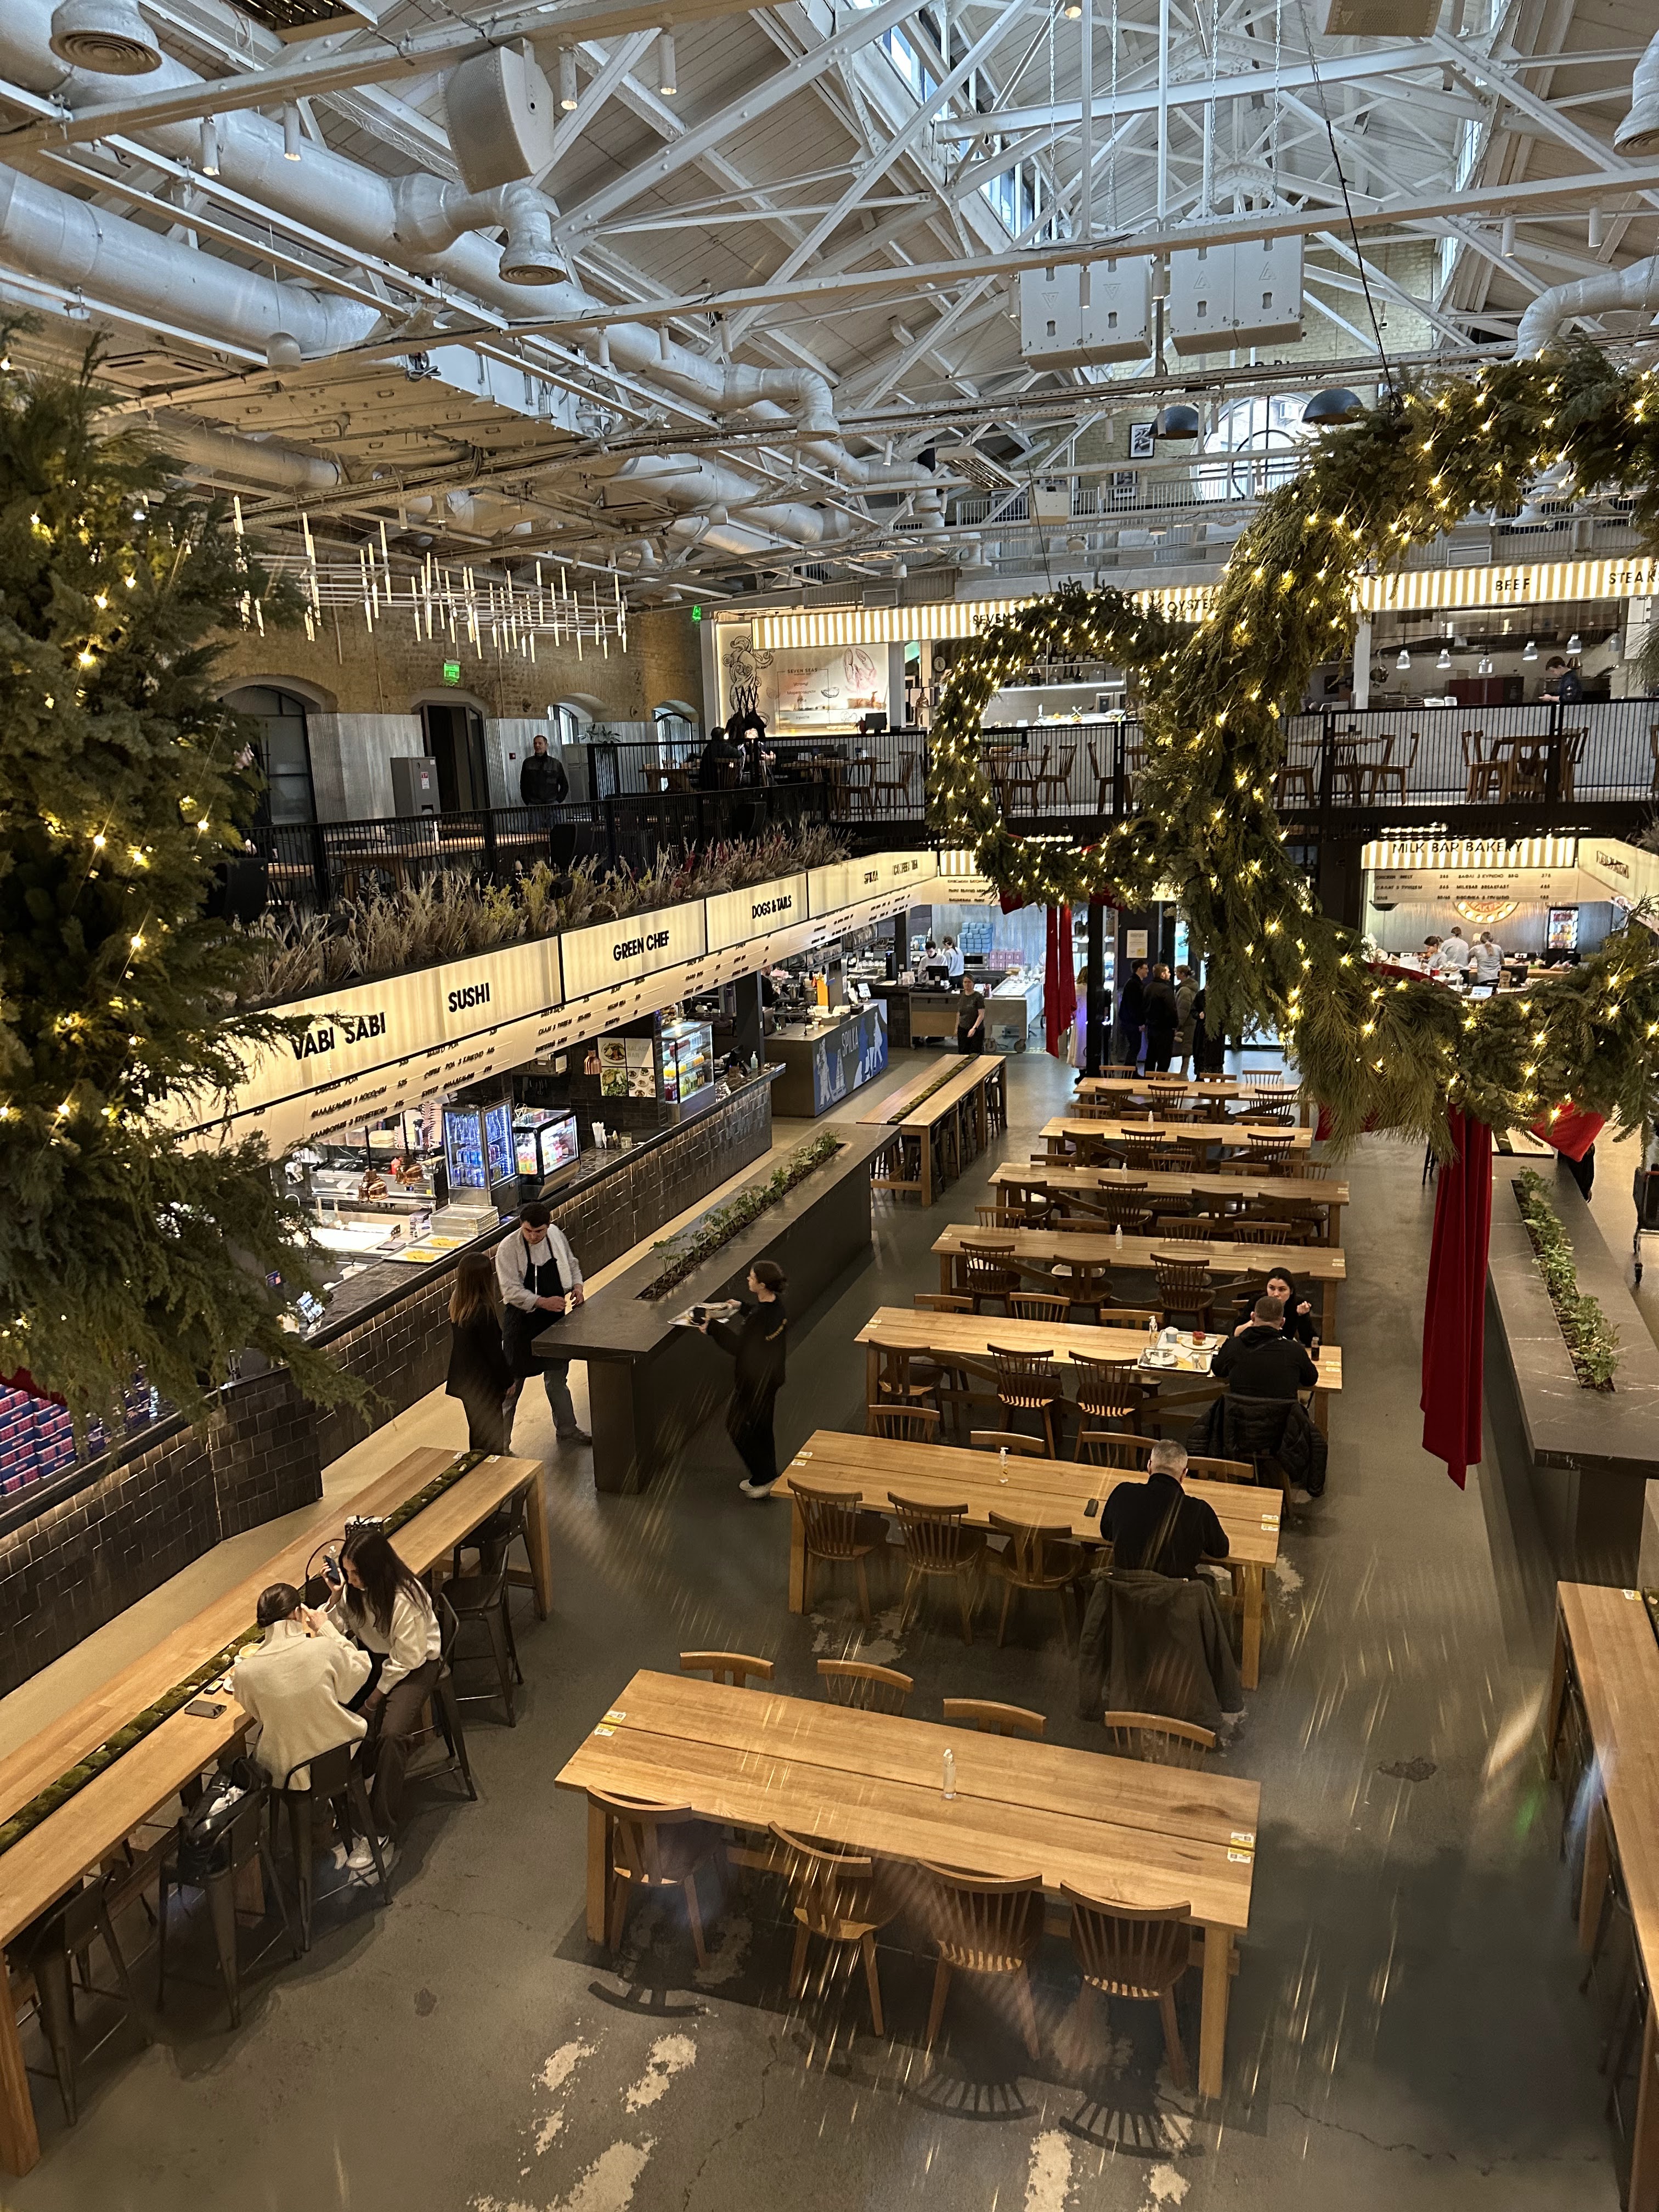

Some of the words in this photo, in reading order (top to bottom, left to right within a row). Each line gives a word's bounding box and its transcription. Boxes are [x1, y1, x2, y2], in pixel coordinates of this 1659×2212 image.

[1496, 578, 1530, 591] BEEF
[1609, 570, 1659, 585] STEAK
[1392, 842, 1425, 854] MILK
[1432, 842, 1459, 853] BAR
[752, 900, 771, 919] DOGS
[772, 900, 777, 913] &
[776, 895, 792, 911] TAILS
[613, 937, 645, 961] GREEN
[646, 930, 669, 951] CHEF
[448, 982, 490, 1013] SUSHI
[342, 1012, 386, 1044] SABI
[842, 1026, 859, 1057] SPILKA
